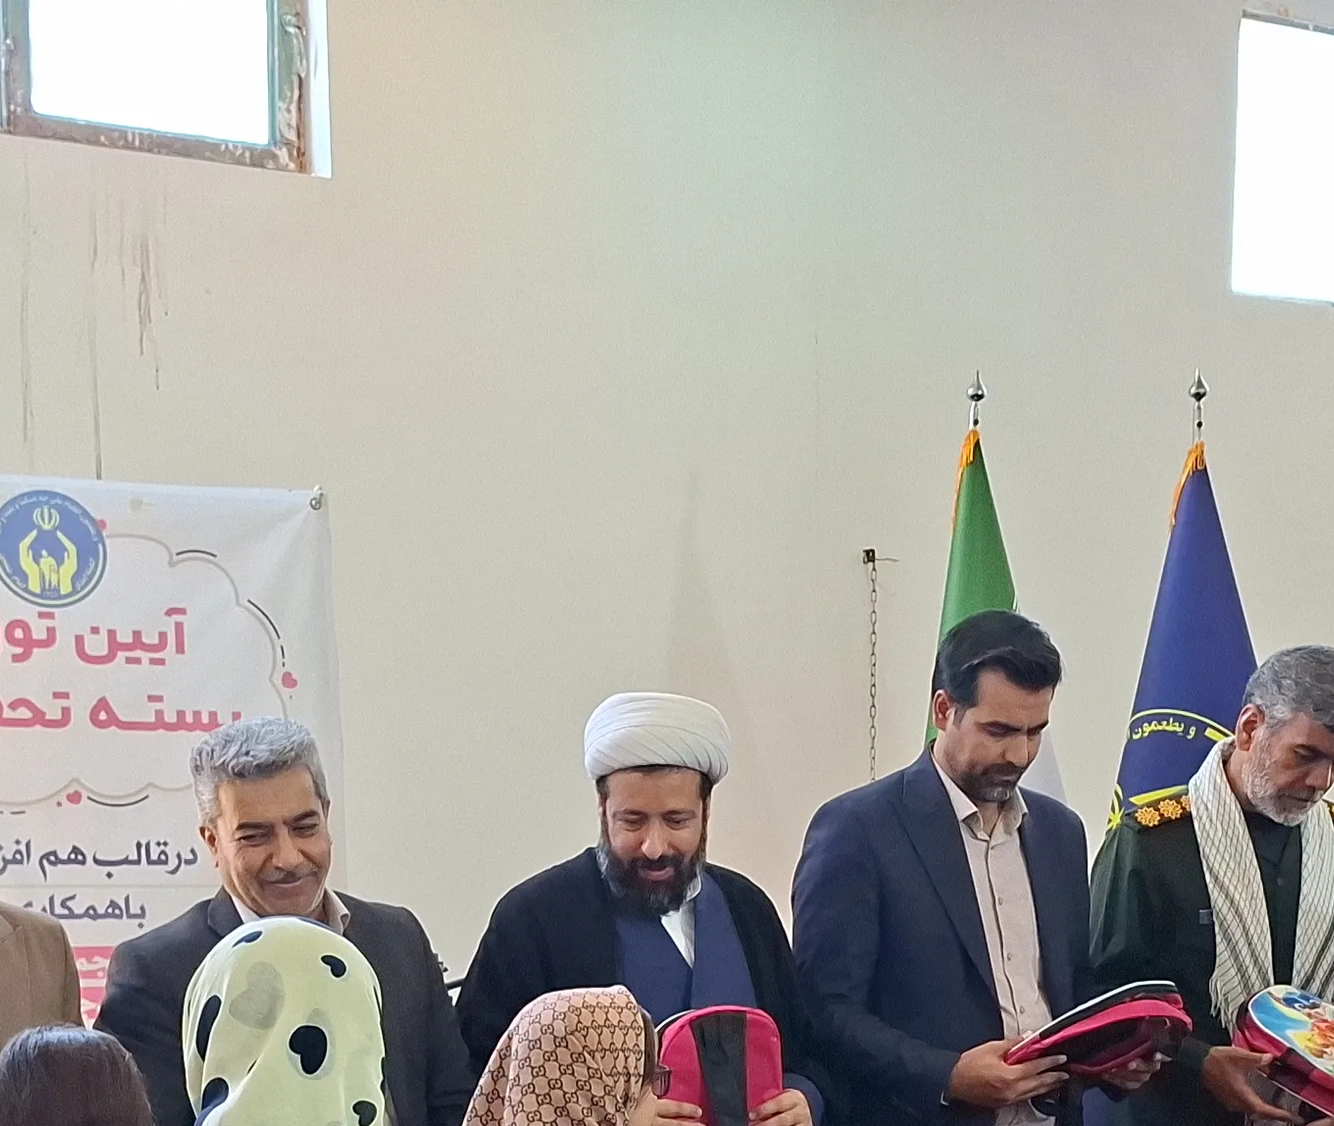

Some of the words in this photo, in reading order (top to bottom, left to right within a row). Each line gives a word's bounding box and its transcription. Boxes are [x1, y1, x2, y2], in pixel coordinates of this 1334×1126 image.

[74, 606, 187, 666] آیین
[1131, 716, 1185, 740] یطعمون
[38, 844, 88, 883] هم
